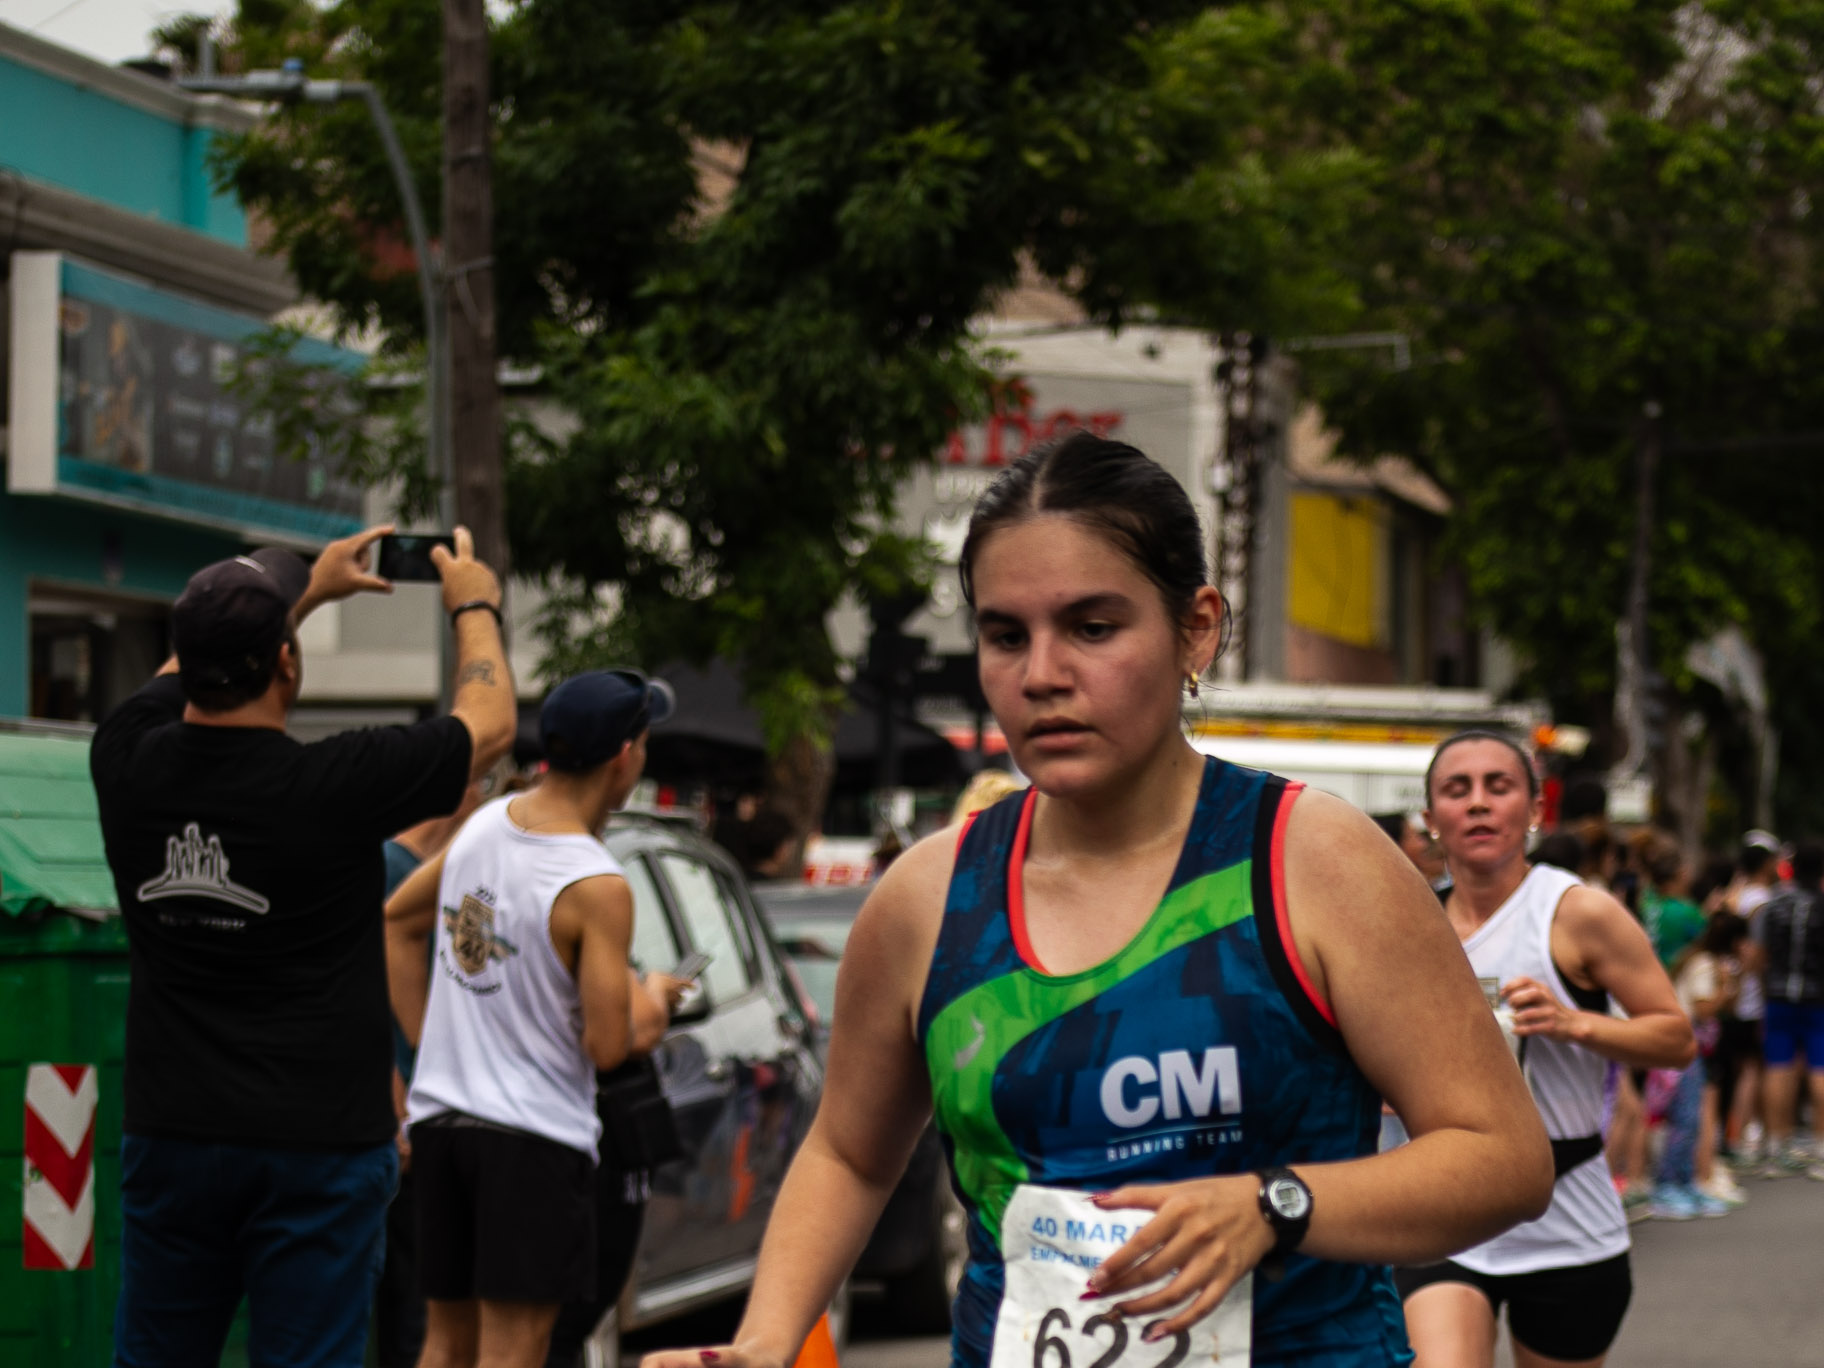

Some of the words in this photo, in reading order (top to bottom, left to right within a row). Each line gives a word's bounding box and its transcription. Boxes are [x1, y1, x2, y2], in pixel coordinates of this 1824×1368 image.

[1100, 1046, 1242, 1128] CM
[1107, 1136, 1185, 1162] RUNNING
[1196, 1130, 1243, 1145] TEAM
[1032, 1216, 1057, 1238] 40
